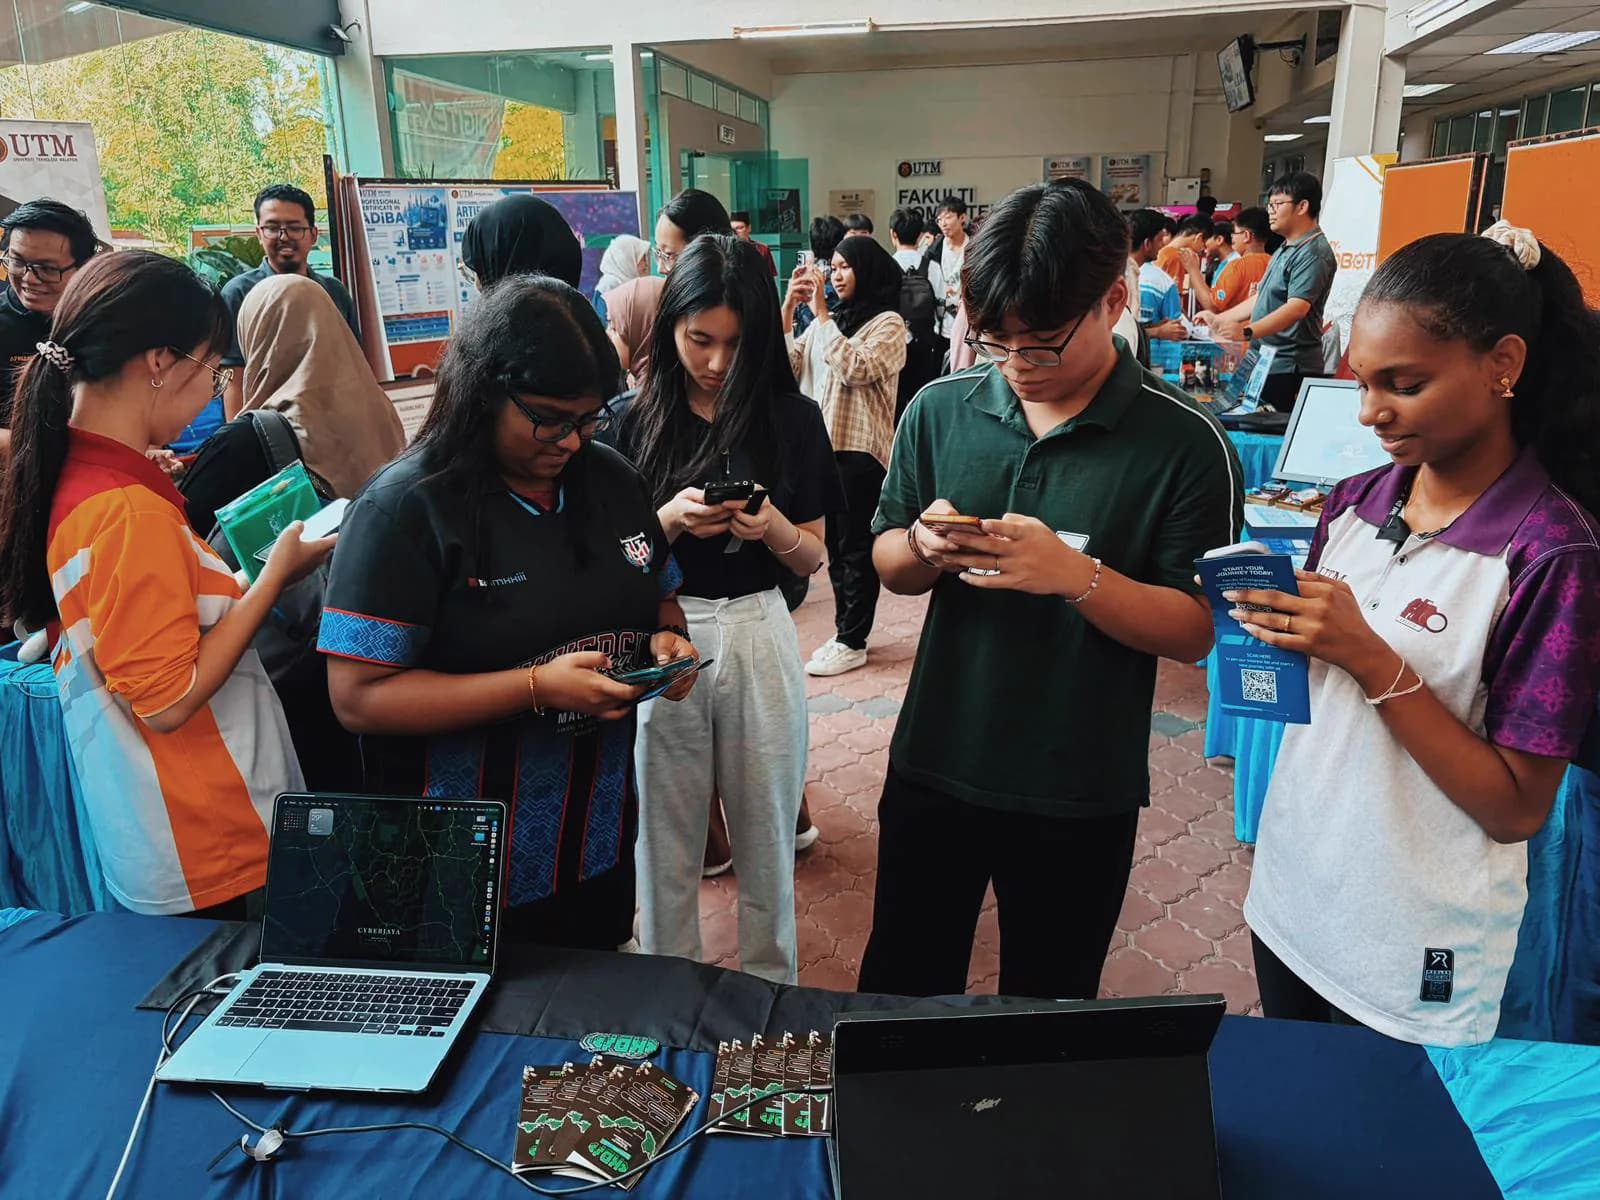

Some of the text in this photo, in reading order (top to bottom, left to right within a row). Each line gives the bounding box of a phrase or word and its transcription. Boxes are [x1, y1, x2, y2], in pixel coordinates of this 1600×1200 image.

[8, 134, 77, 156] UTM
[913, 161, 941, 174] UTM
[357, 927, 400, 935] CYBERJAYA
